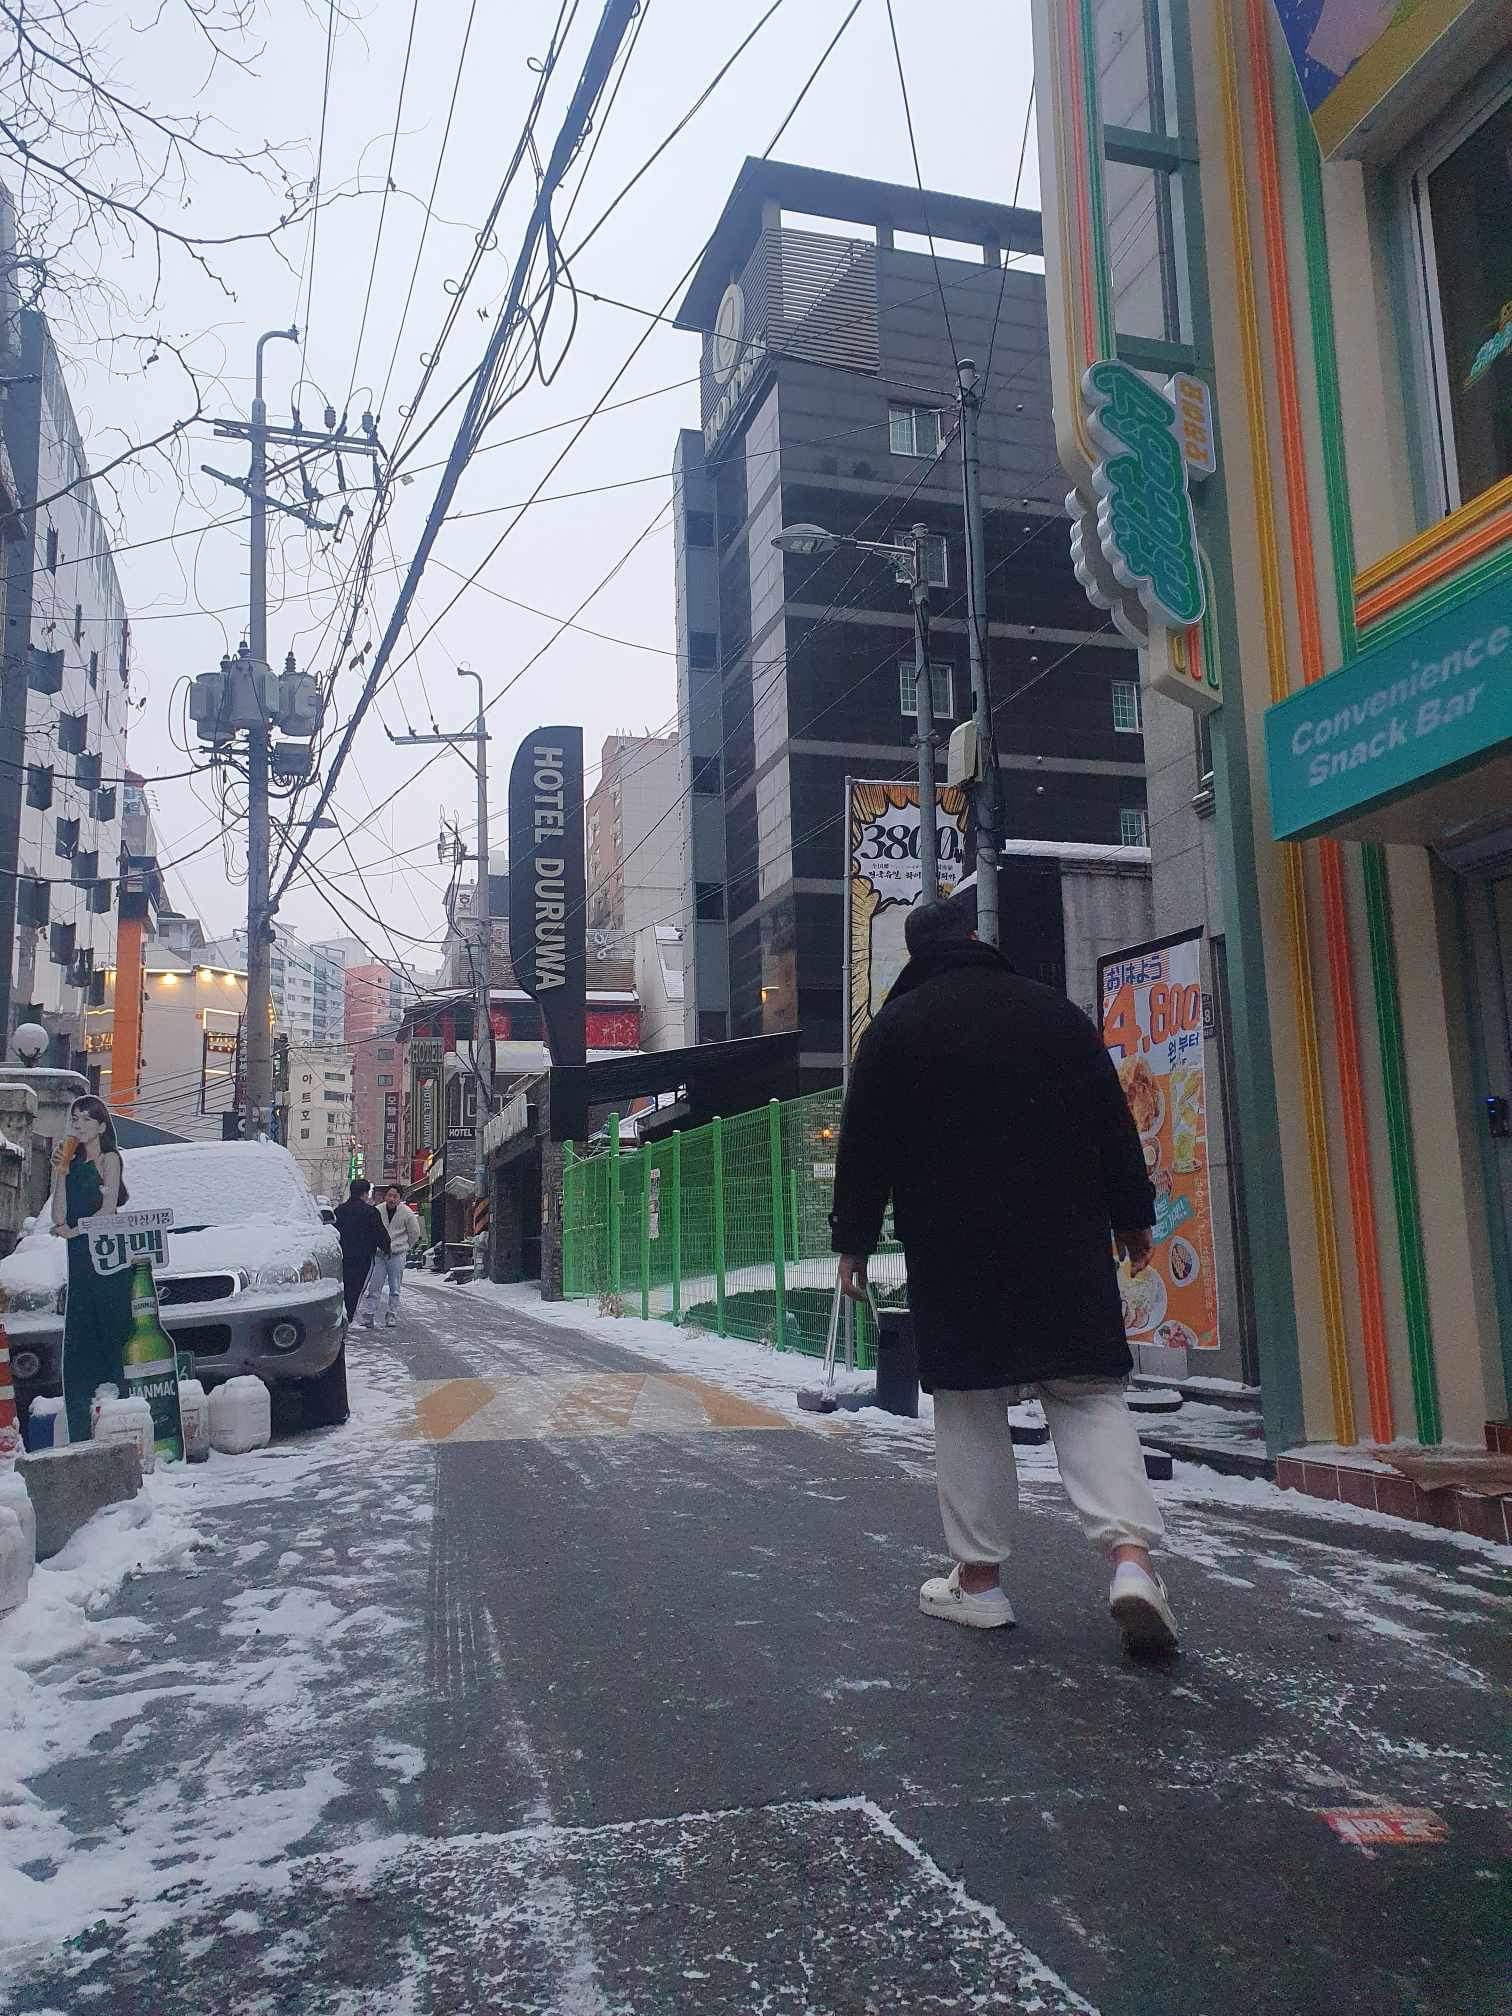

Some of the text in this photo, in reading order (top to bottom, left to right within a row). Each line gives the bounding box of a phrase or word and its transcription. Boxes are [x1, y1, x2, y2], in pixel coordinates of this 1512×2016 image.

[1290, 625, 1511, 754] Convenience
[1308, 683, 1487, 788] Snack Bar
[533, 745, 566, 991] HOTEL DURUWA
[448, 1128, 473, 1137] HOTEL
[94, 1229, 164, 1271] 한맥
[129, 1379, 176, 1400] HANMAC
